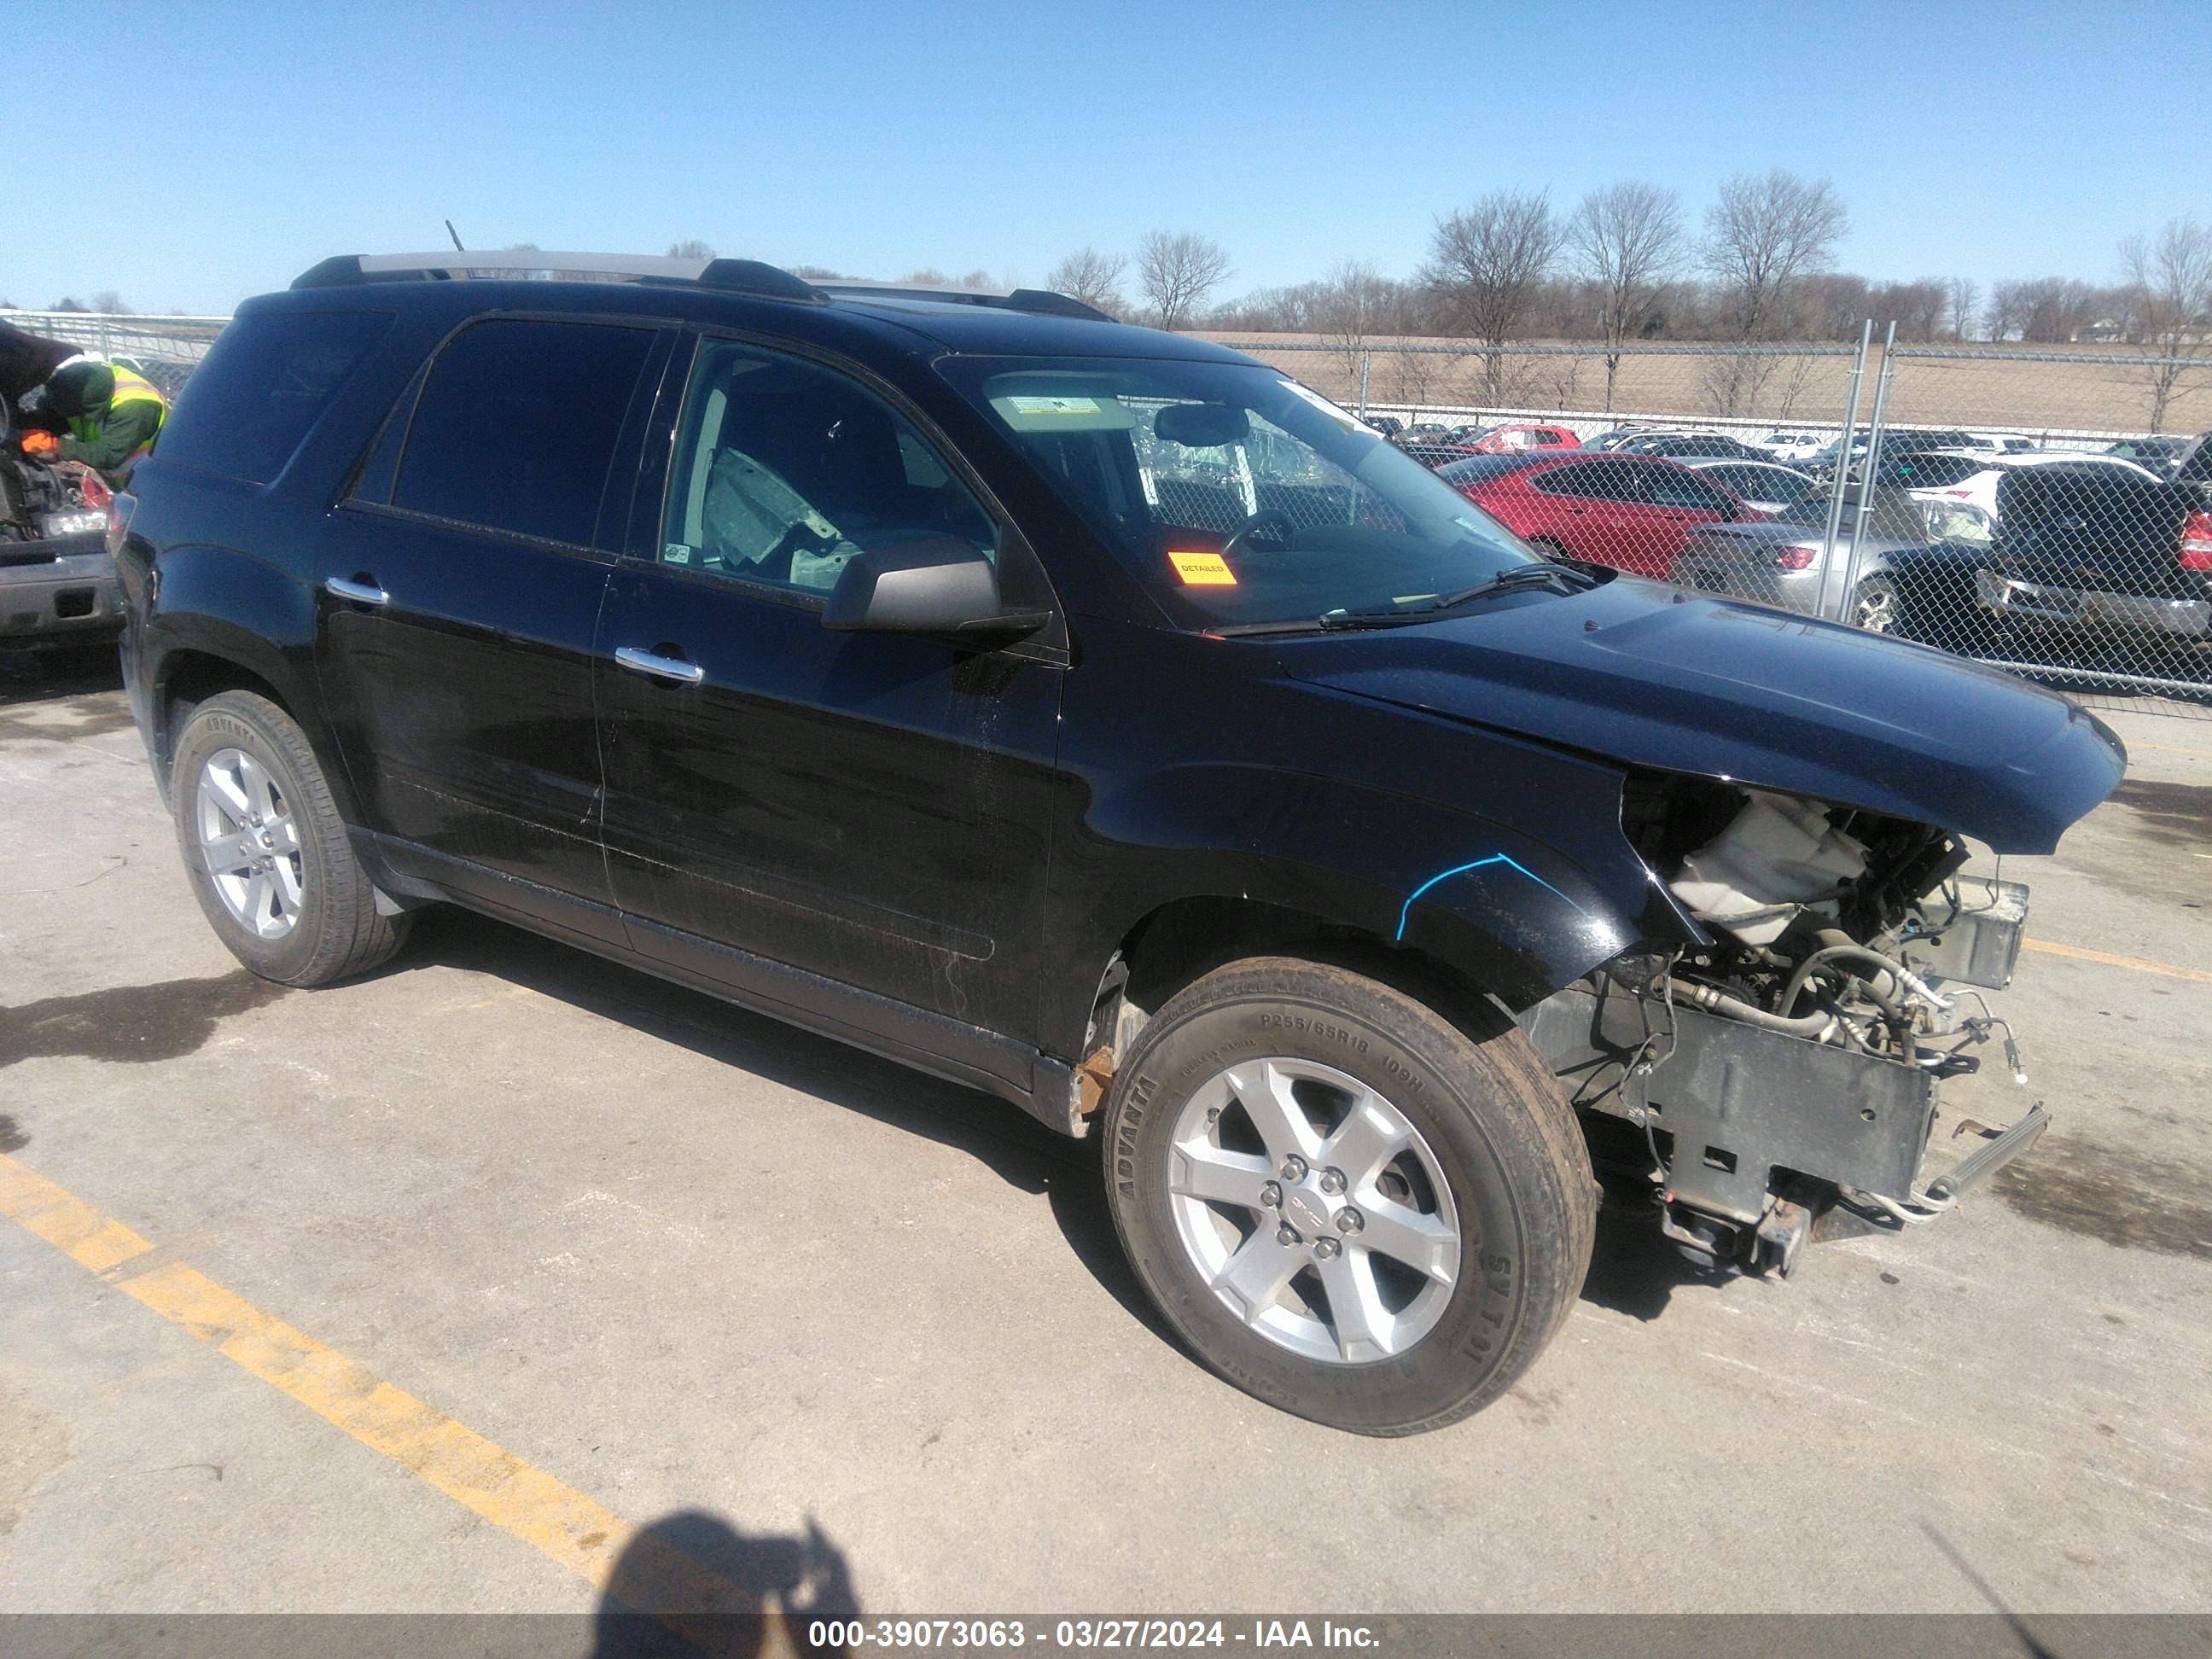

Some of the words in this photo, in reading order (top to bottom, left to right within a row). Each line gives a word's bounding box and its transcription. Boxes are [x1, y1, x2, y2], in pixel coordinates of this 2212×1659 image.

[1260, 1013, 1370, 1052] P255/65R18
[1383, 1056, 1425, 1092] 109H
[1117, 1073, 1159, 1201] ADVANTA
[1291, 1196, 1324, 1227] GC
